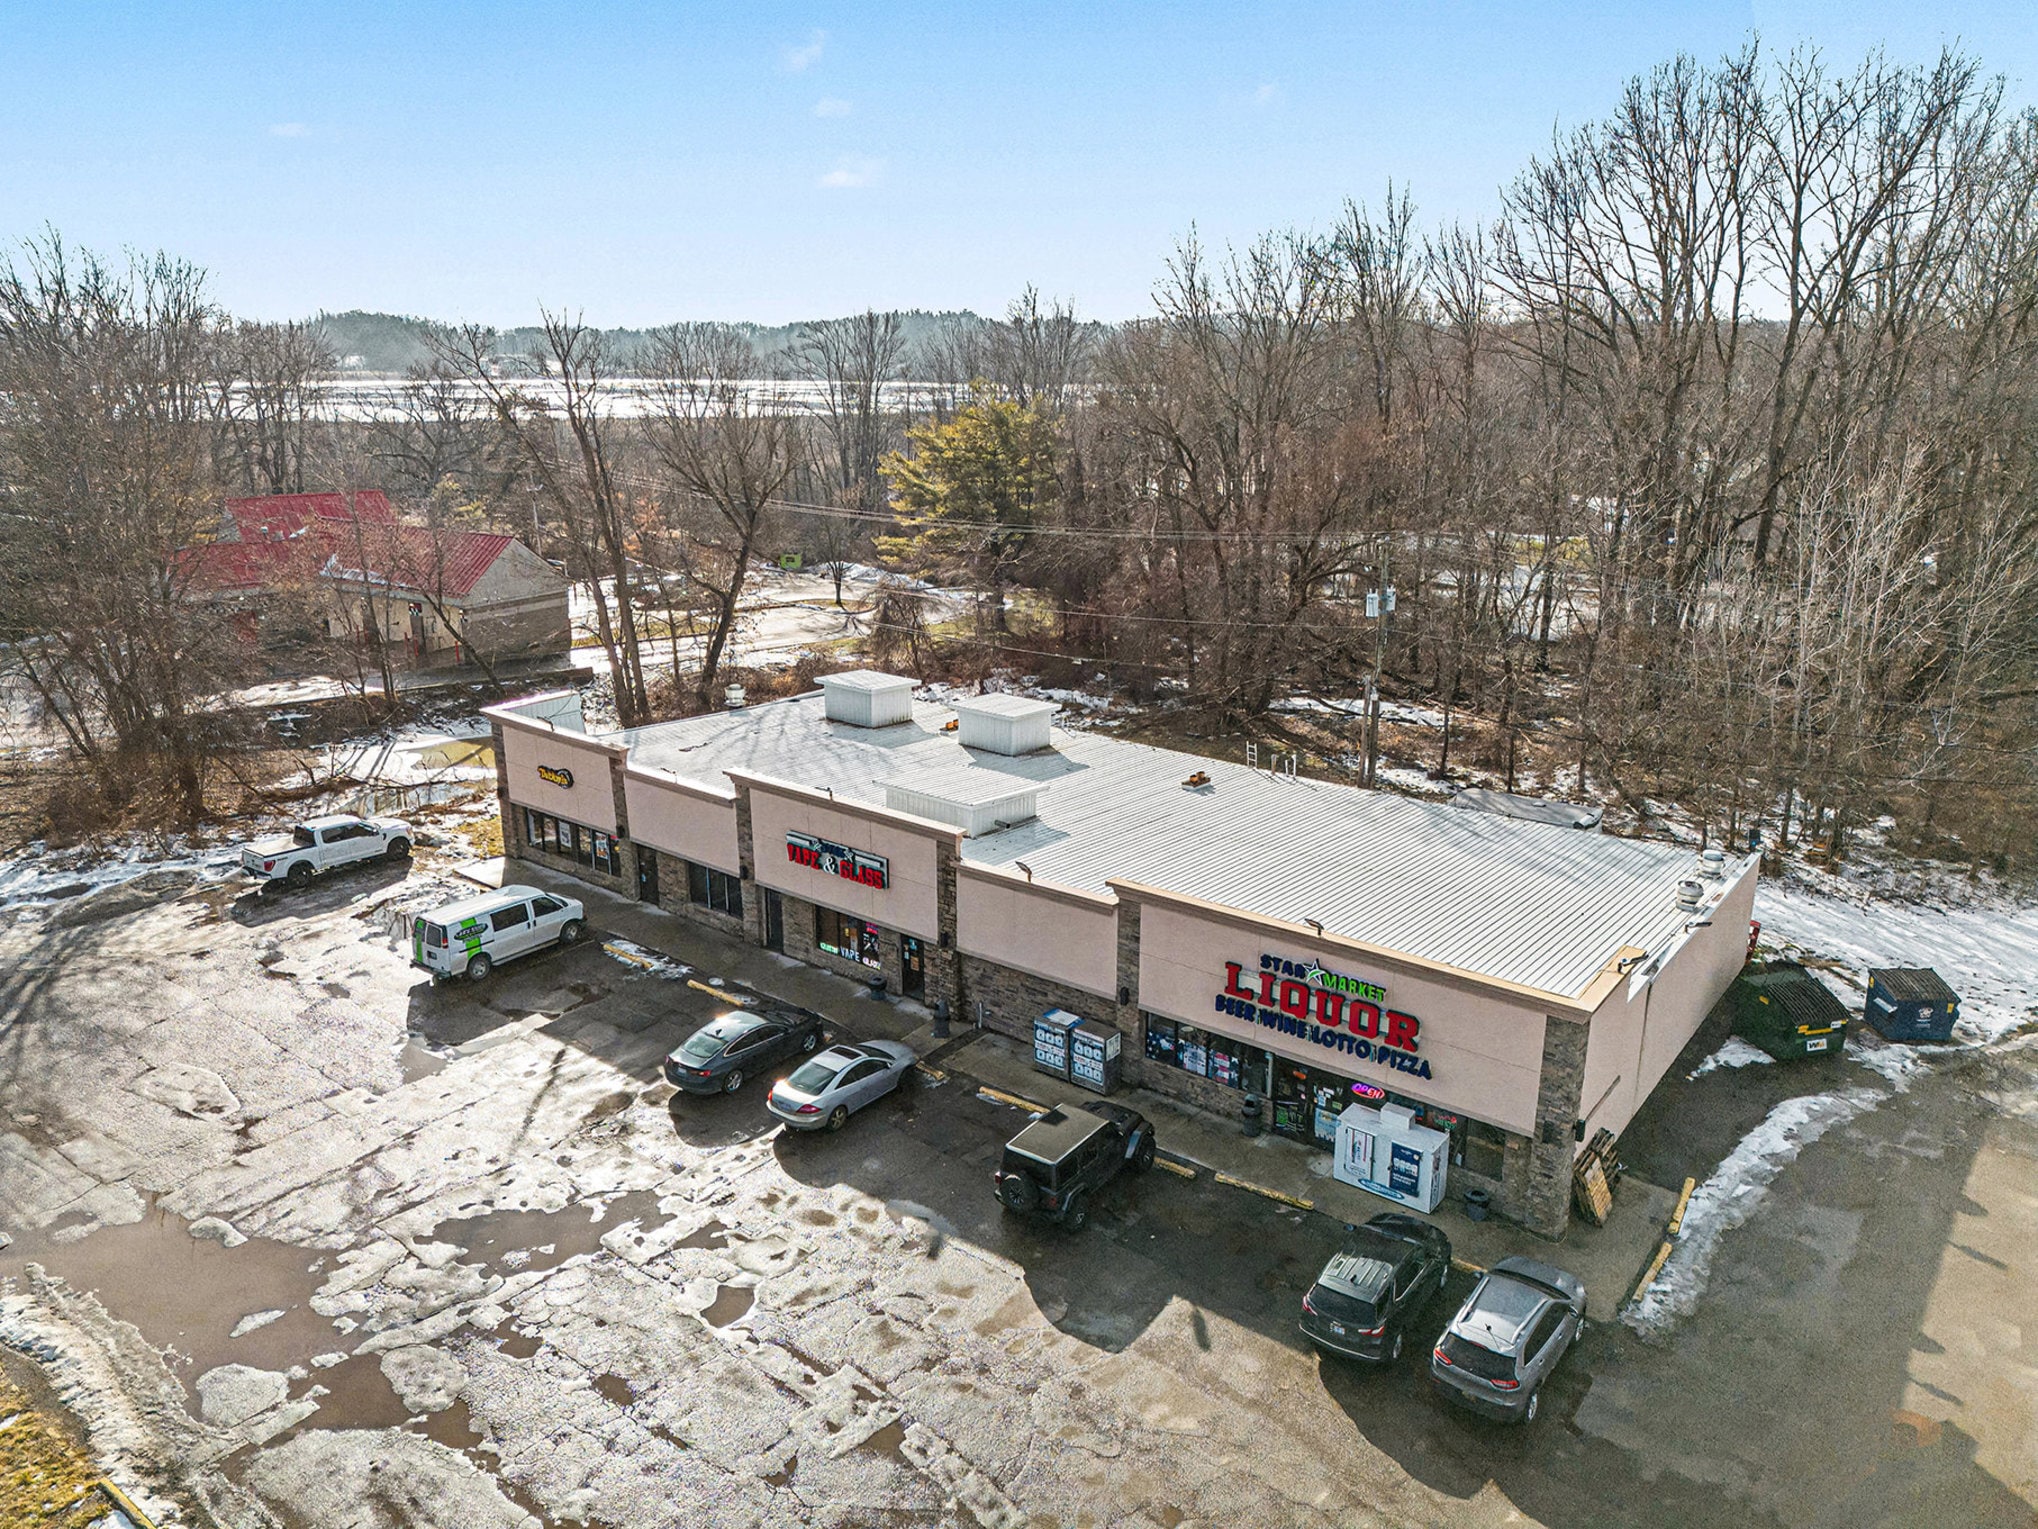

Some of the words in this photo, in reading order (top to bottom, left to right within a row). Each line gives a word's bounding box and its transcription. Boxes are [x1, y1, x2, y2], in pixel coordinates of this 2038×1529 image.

[787, 843, 820, 870] VAPE
[823, 856, 836, 874] &
[840, 860, 883, 889] GLASS
[1260, 954, 1306, 979] STAR
[1323, 972, 1386, 1003] MARKET
[1224, 961, 1420, 1052] LIQUOR
[1215, 994, 1257, 1022] BEER
[1259, 1009, 1307, 1039] WINE
[1311, 1025, 1371, 1059] LOTTO
[1377, 1046, 1432, 1080] PIZZA
[1352, 1083, 1381, 1099] OPEN
